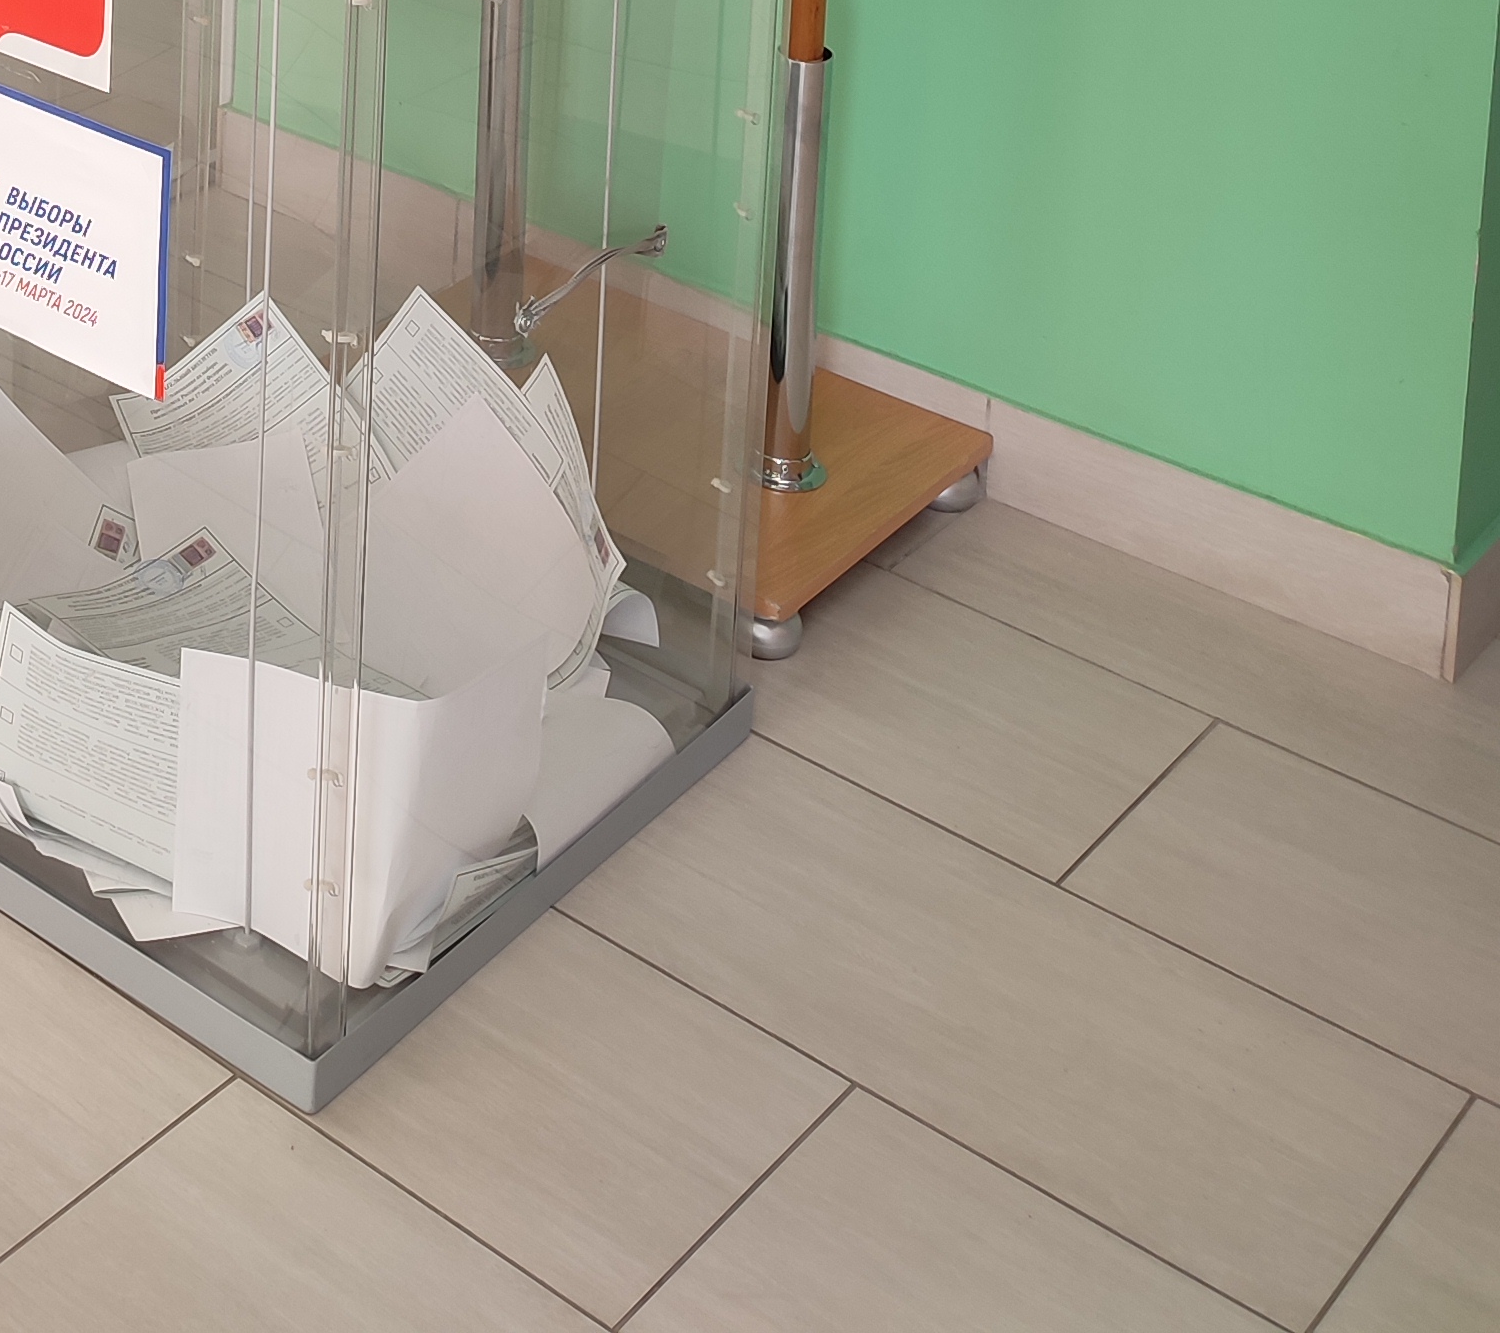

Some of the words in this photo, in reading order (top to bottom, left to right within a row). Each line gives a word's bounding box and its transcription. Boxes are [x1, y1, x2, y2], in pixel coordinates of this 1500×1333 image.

[5, 186, 92, 238] ВЫБОРЫ
[15, 277, 62, 312] МАРТА
[63, 299, 99, 327] 2024
